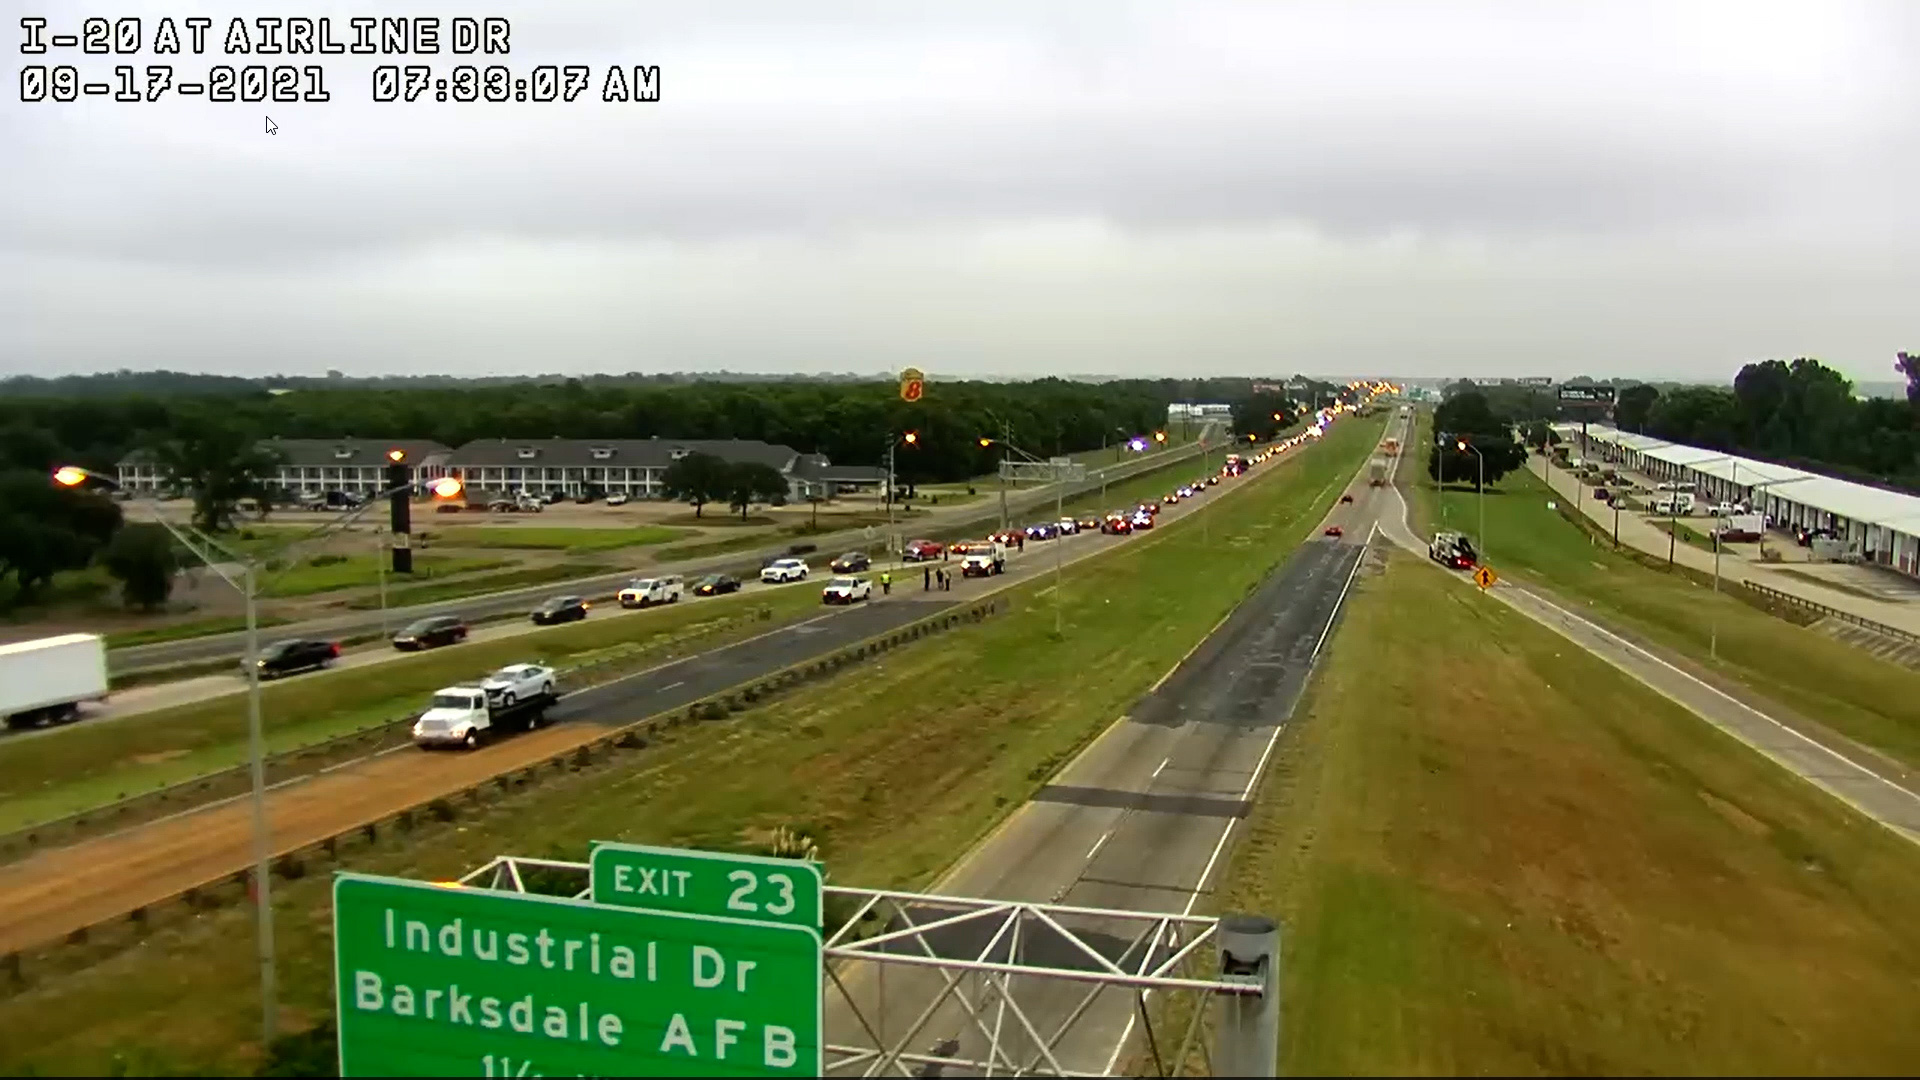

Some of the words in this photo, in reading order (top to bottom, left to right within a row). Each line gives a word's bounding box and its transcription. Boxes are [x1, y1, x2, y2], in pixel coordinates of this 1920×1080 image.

[614, 865, 692, 897] EXIT
[727, 870, 796, 915] 23
[386, 909, 658, 983] Industrial
[693, 945, 757, 992] Dr
[355, 971, 624, 1046] Barksdale
